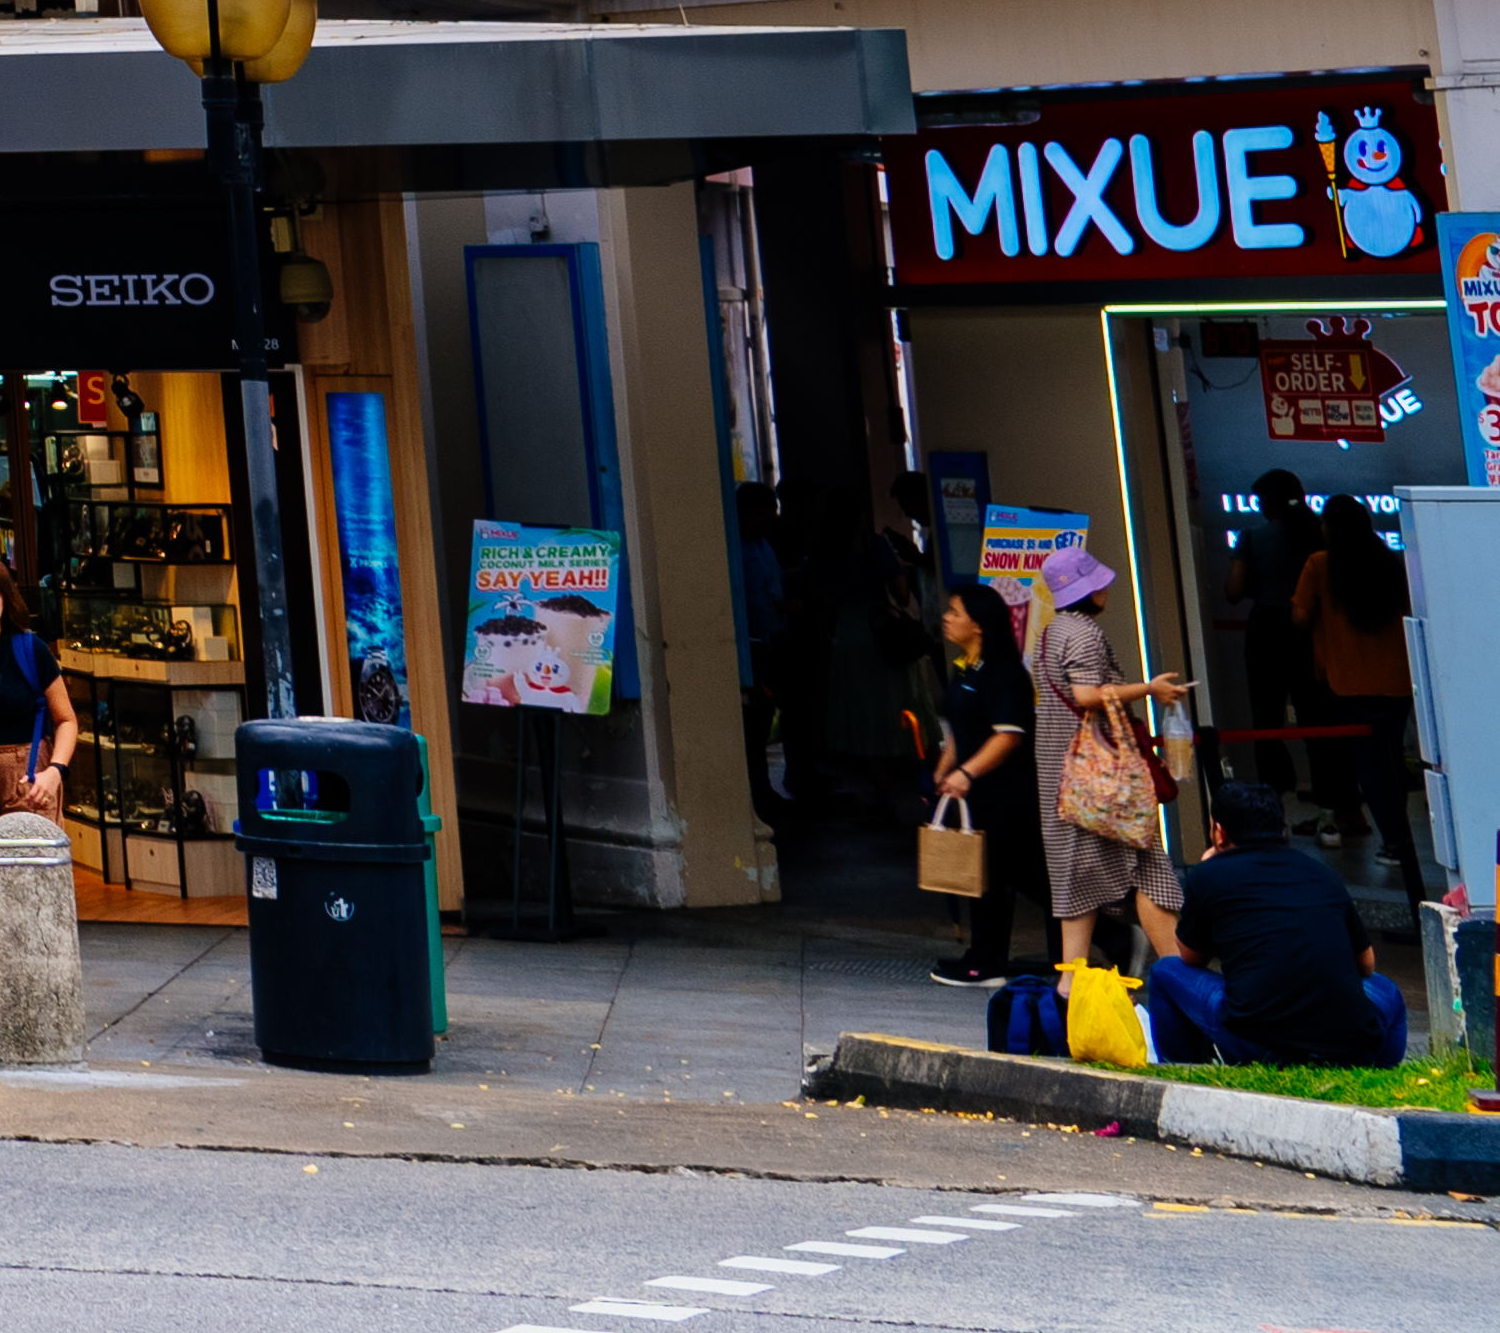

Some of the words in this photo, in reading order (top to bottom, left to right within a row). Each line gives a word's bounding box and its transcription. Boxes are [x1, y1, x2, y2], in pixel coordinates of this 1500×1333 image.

[924, 126, 1304, 260] MIXUE
[51, 272, 215, 307] SEIKO
[1290, 353, 1342, 371] SELF-
[1275, 372, 1347, 392] ORDER
[1235, 493, 1260, 513] LO
[481, 546, 520, 559] RICH
[522, 546, 534, 559] &
[536, 544, 610, 559] CREAMY
[984, 552, 1020, 570] SNOW
[479, 559, 535, 570] COCONUT
[538, 559, 565, 568] MILK
[569, 558, 609, 568] SERIES
[478, 571, 524, 588] SAY
[529, 569, 608, 587] YEAH!!
